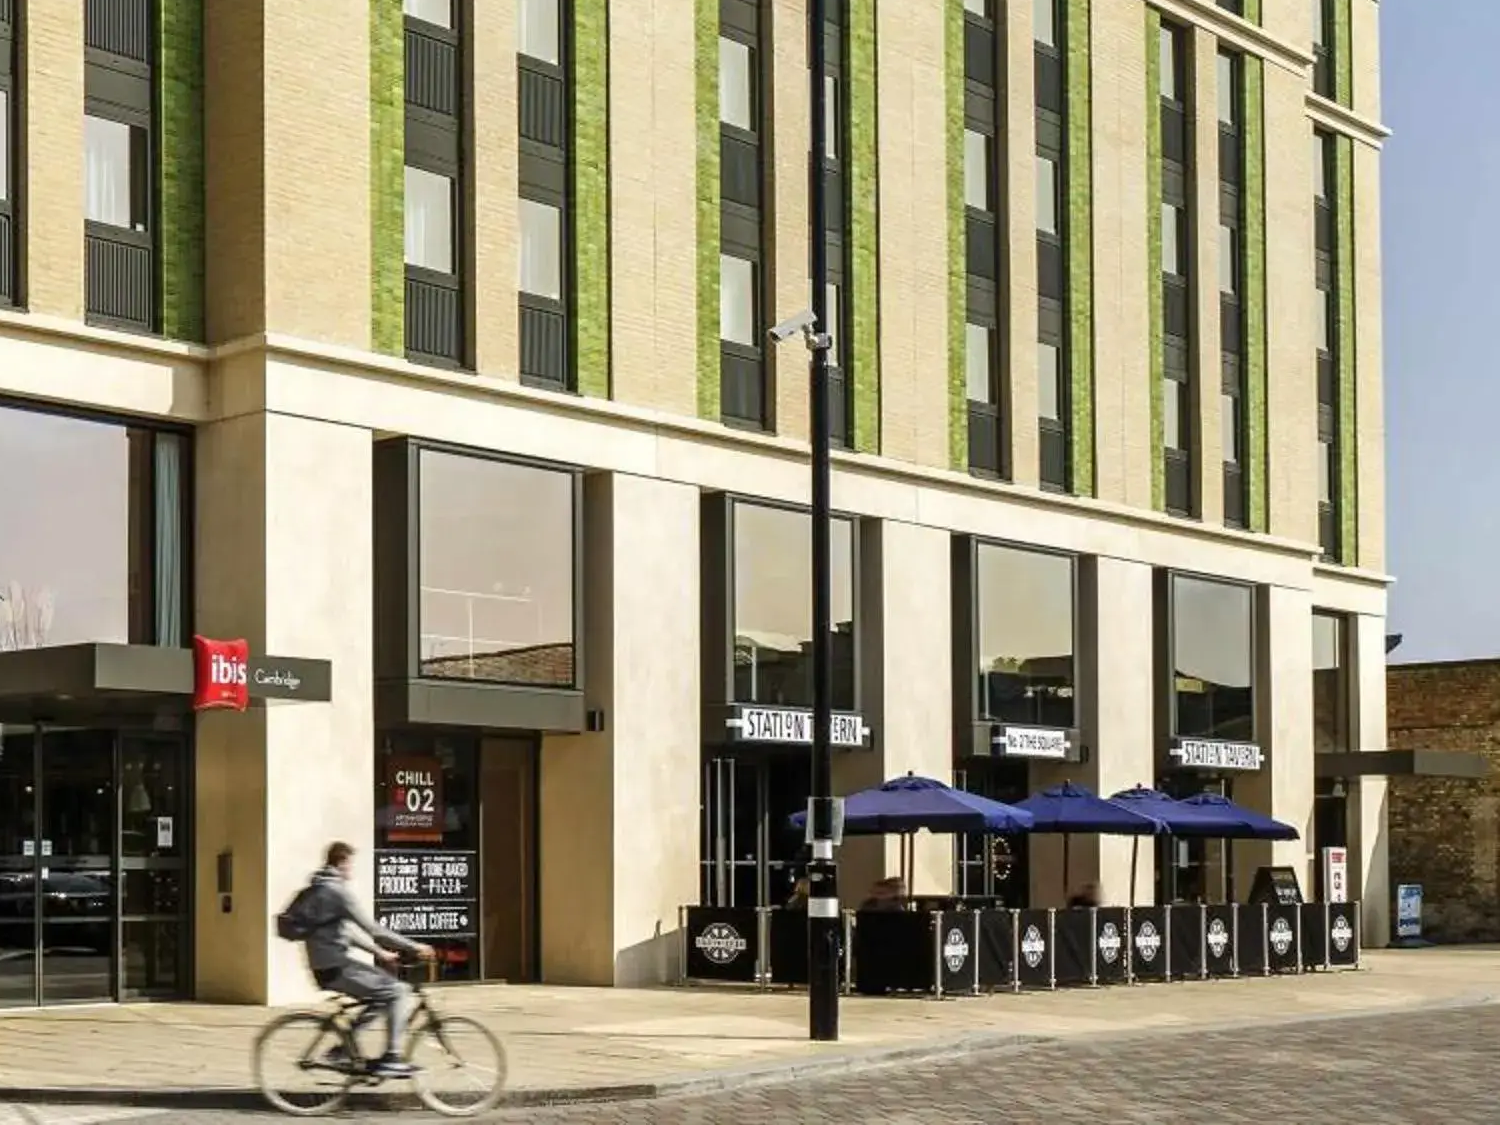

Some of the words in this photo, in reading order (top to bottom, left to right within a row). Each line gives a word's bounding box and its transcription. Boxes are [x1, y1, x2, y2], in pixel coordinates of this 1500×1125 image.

[211, 653, 247, 685] ibis
[254, 668, 301, 690] Cambridge
[747, 710, 804, 740] STATION
[807, 714, 858, 743] TERN
[395, 771, 435, 786] CHILL
[406, 788, 435, 812] 02
[379, 876, 419, 894] PRODUCE
[429, 878, 461, 894] PIZZA
[389, 913, 427, 930] ARTISAN
[429, 912, 459, 930] COFFEE
